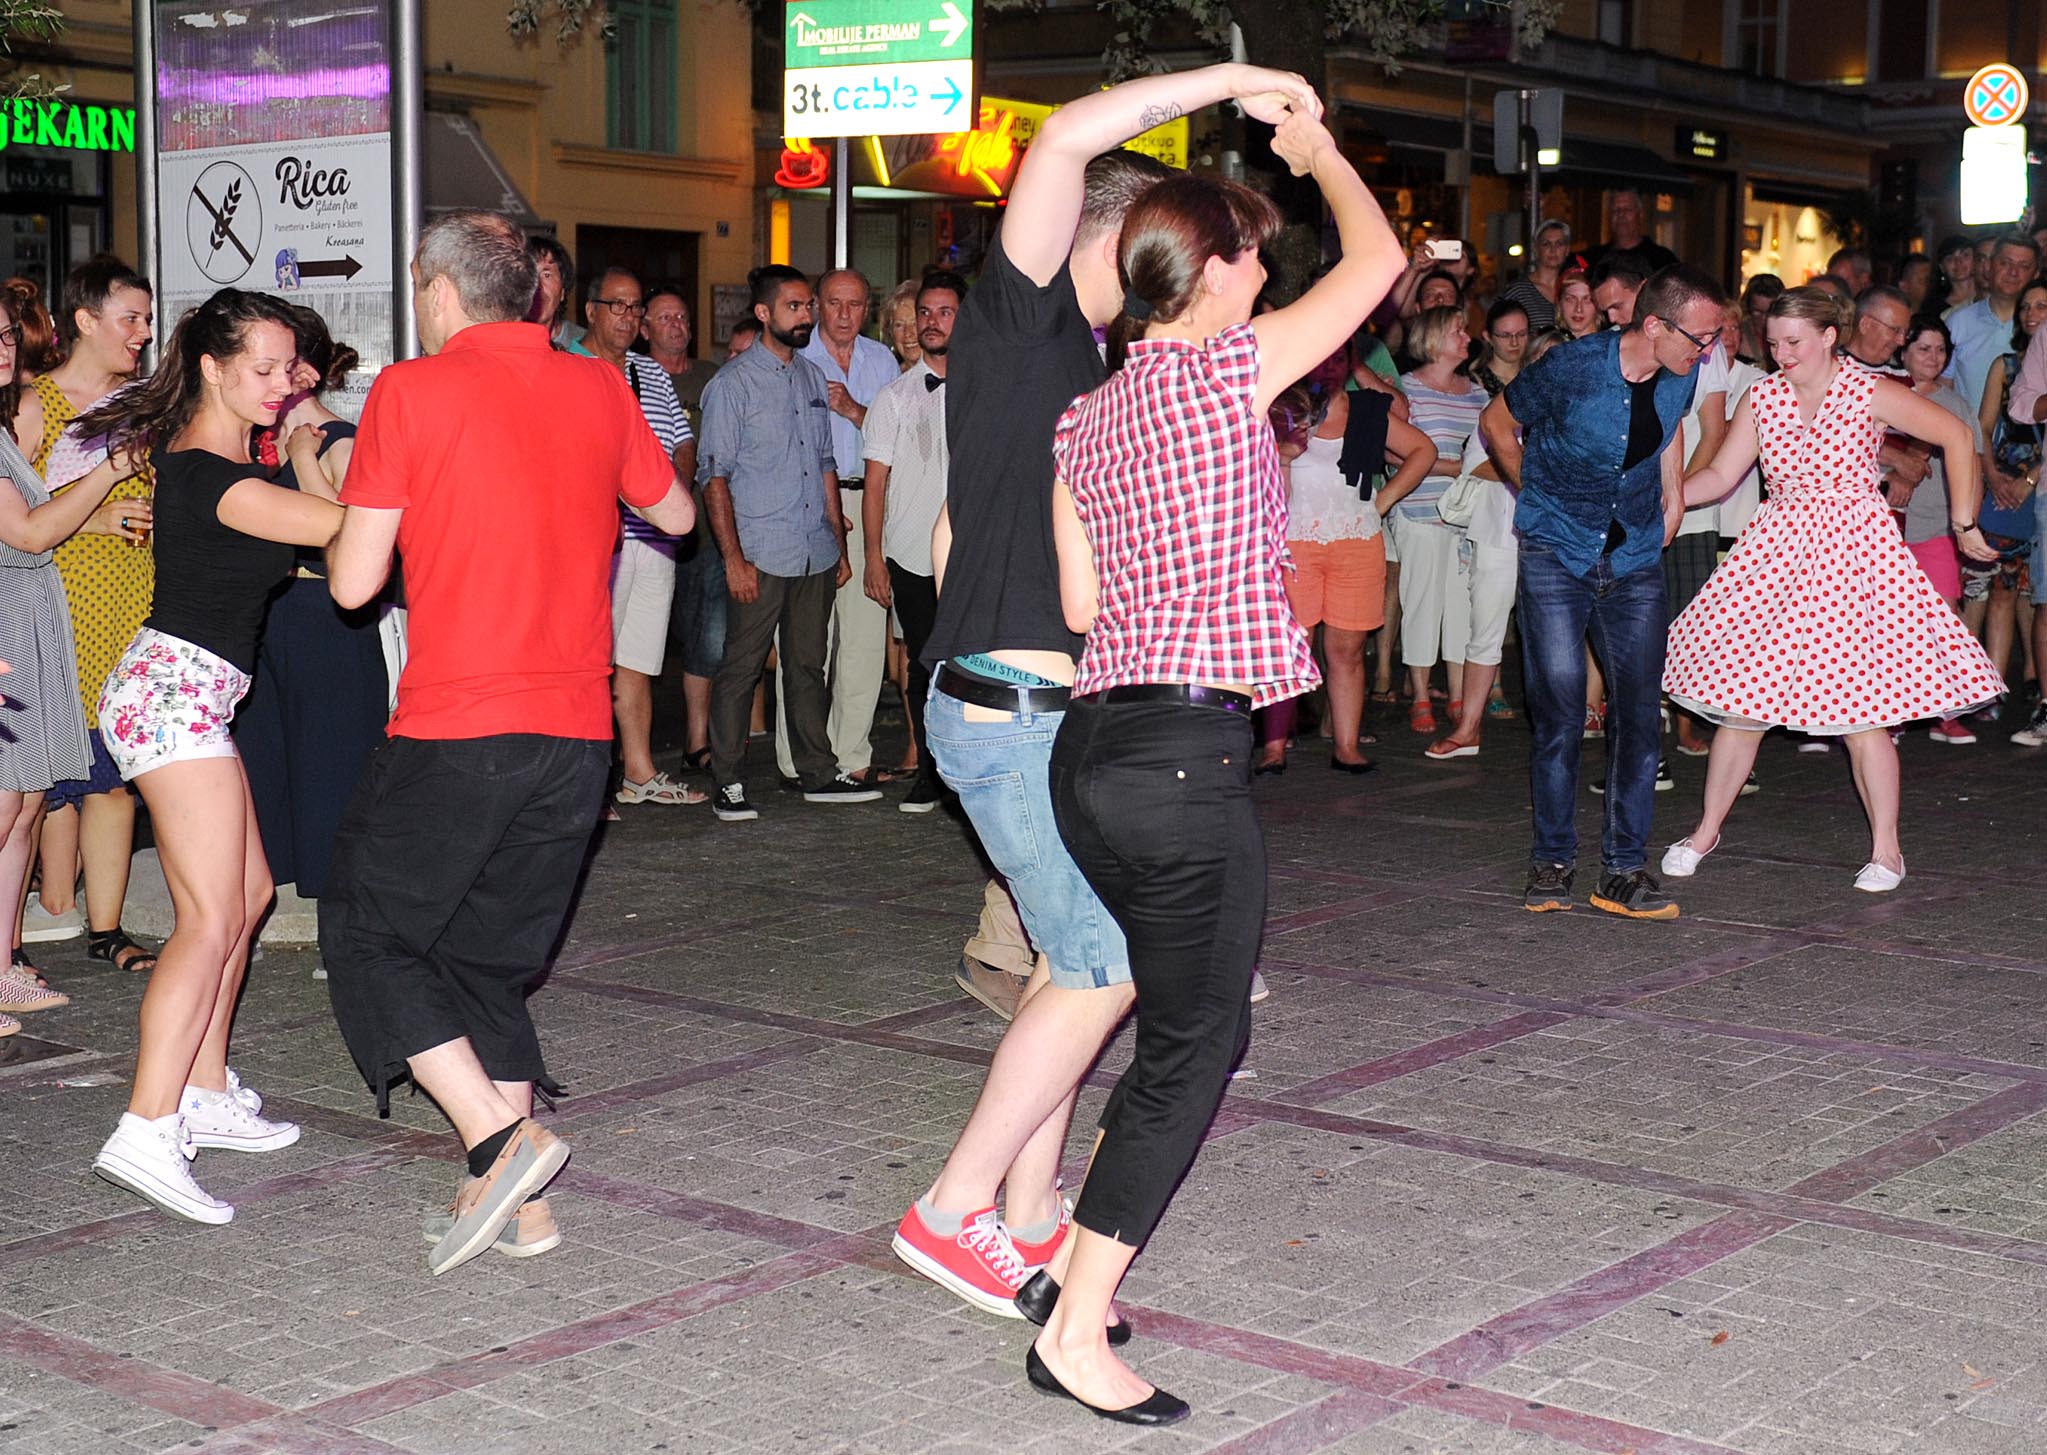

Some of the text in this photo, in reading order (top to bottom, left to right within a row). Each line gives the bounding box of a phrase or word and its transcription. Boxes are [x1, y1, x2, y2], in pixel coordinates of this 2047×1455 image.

[865, 23, 920, 42] PERMAN
[275, 156, 351, 210] Rica
[316, 198, 358, 216] Gluten free
[310, 220, 331, 231] Bakery
[969, 655, 1031, 683] DENIM STYLE
